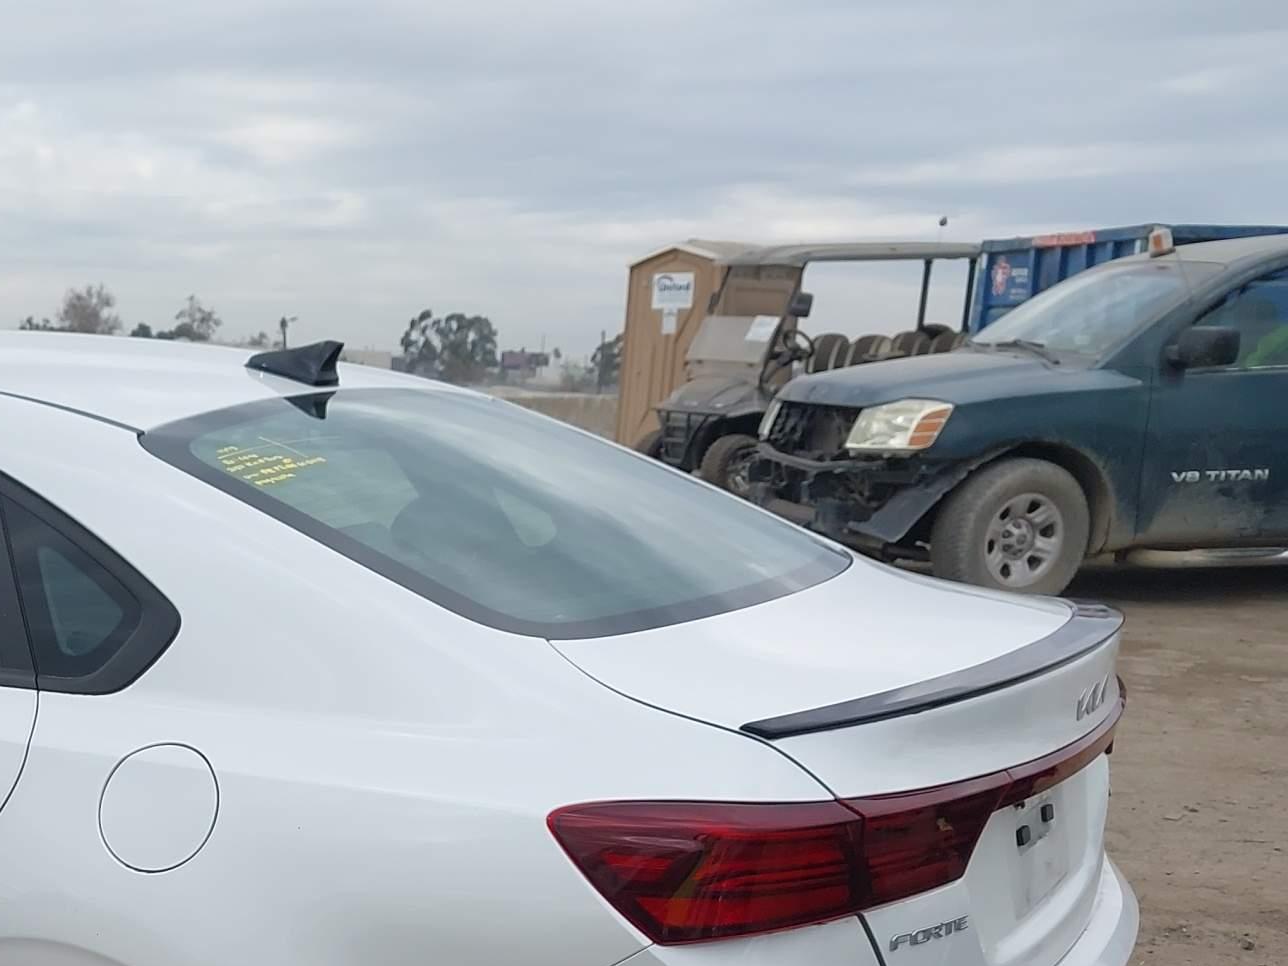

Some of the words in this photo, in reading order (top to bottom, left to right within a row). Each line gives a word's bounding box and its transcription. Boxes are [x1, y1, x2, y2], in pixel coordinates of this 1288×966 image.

[1171, 470, 1200, 482] V8
[1205, 468, 1269, 482] TITAN
[889, 914, 969, 952] FORTE
